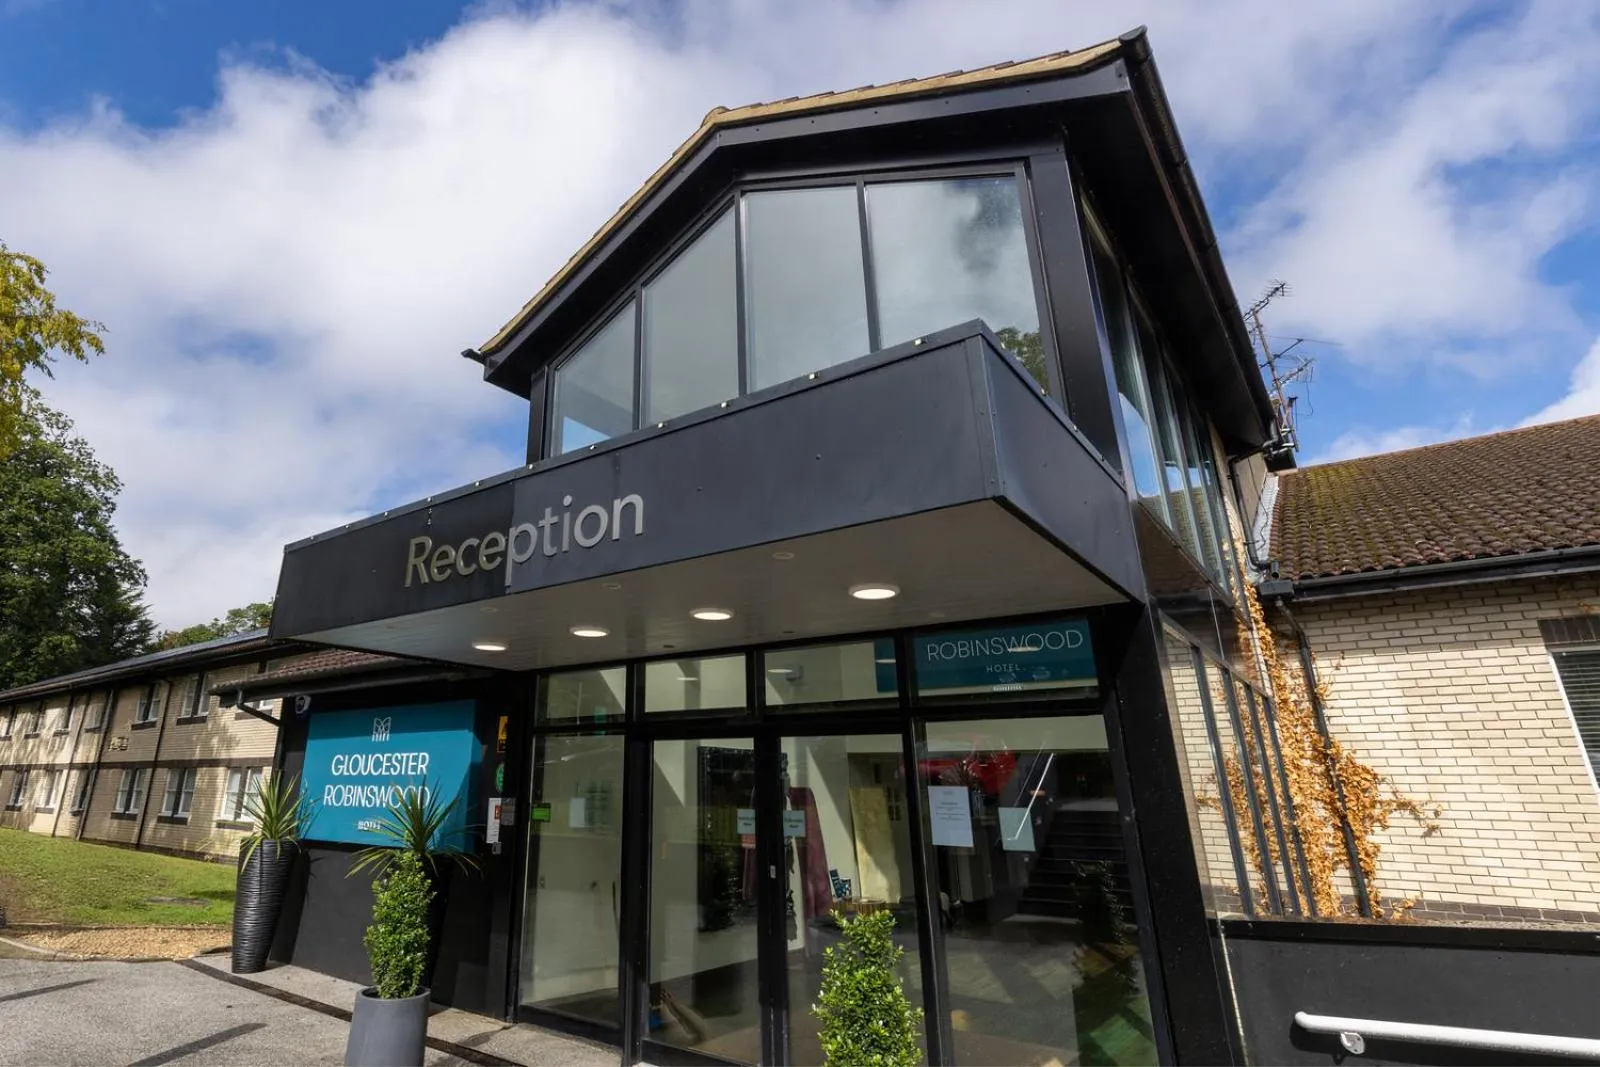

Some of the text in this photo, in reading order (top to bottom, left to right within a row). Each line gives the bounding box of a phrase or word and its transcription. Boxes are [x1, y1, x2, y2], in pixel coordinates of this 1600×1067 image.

[404, 494, 644, 588] Reception
[927, 629, 1083, 661] ROBINSWOOD
[986, 664, 1021, 673] HOTEL
[331, 752, 430, 776] GLOUCESTER
